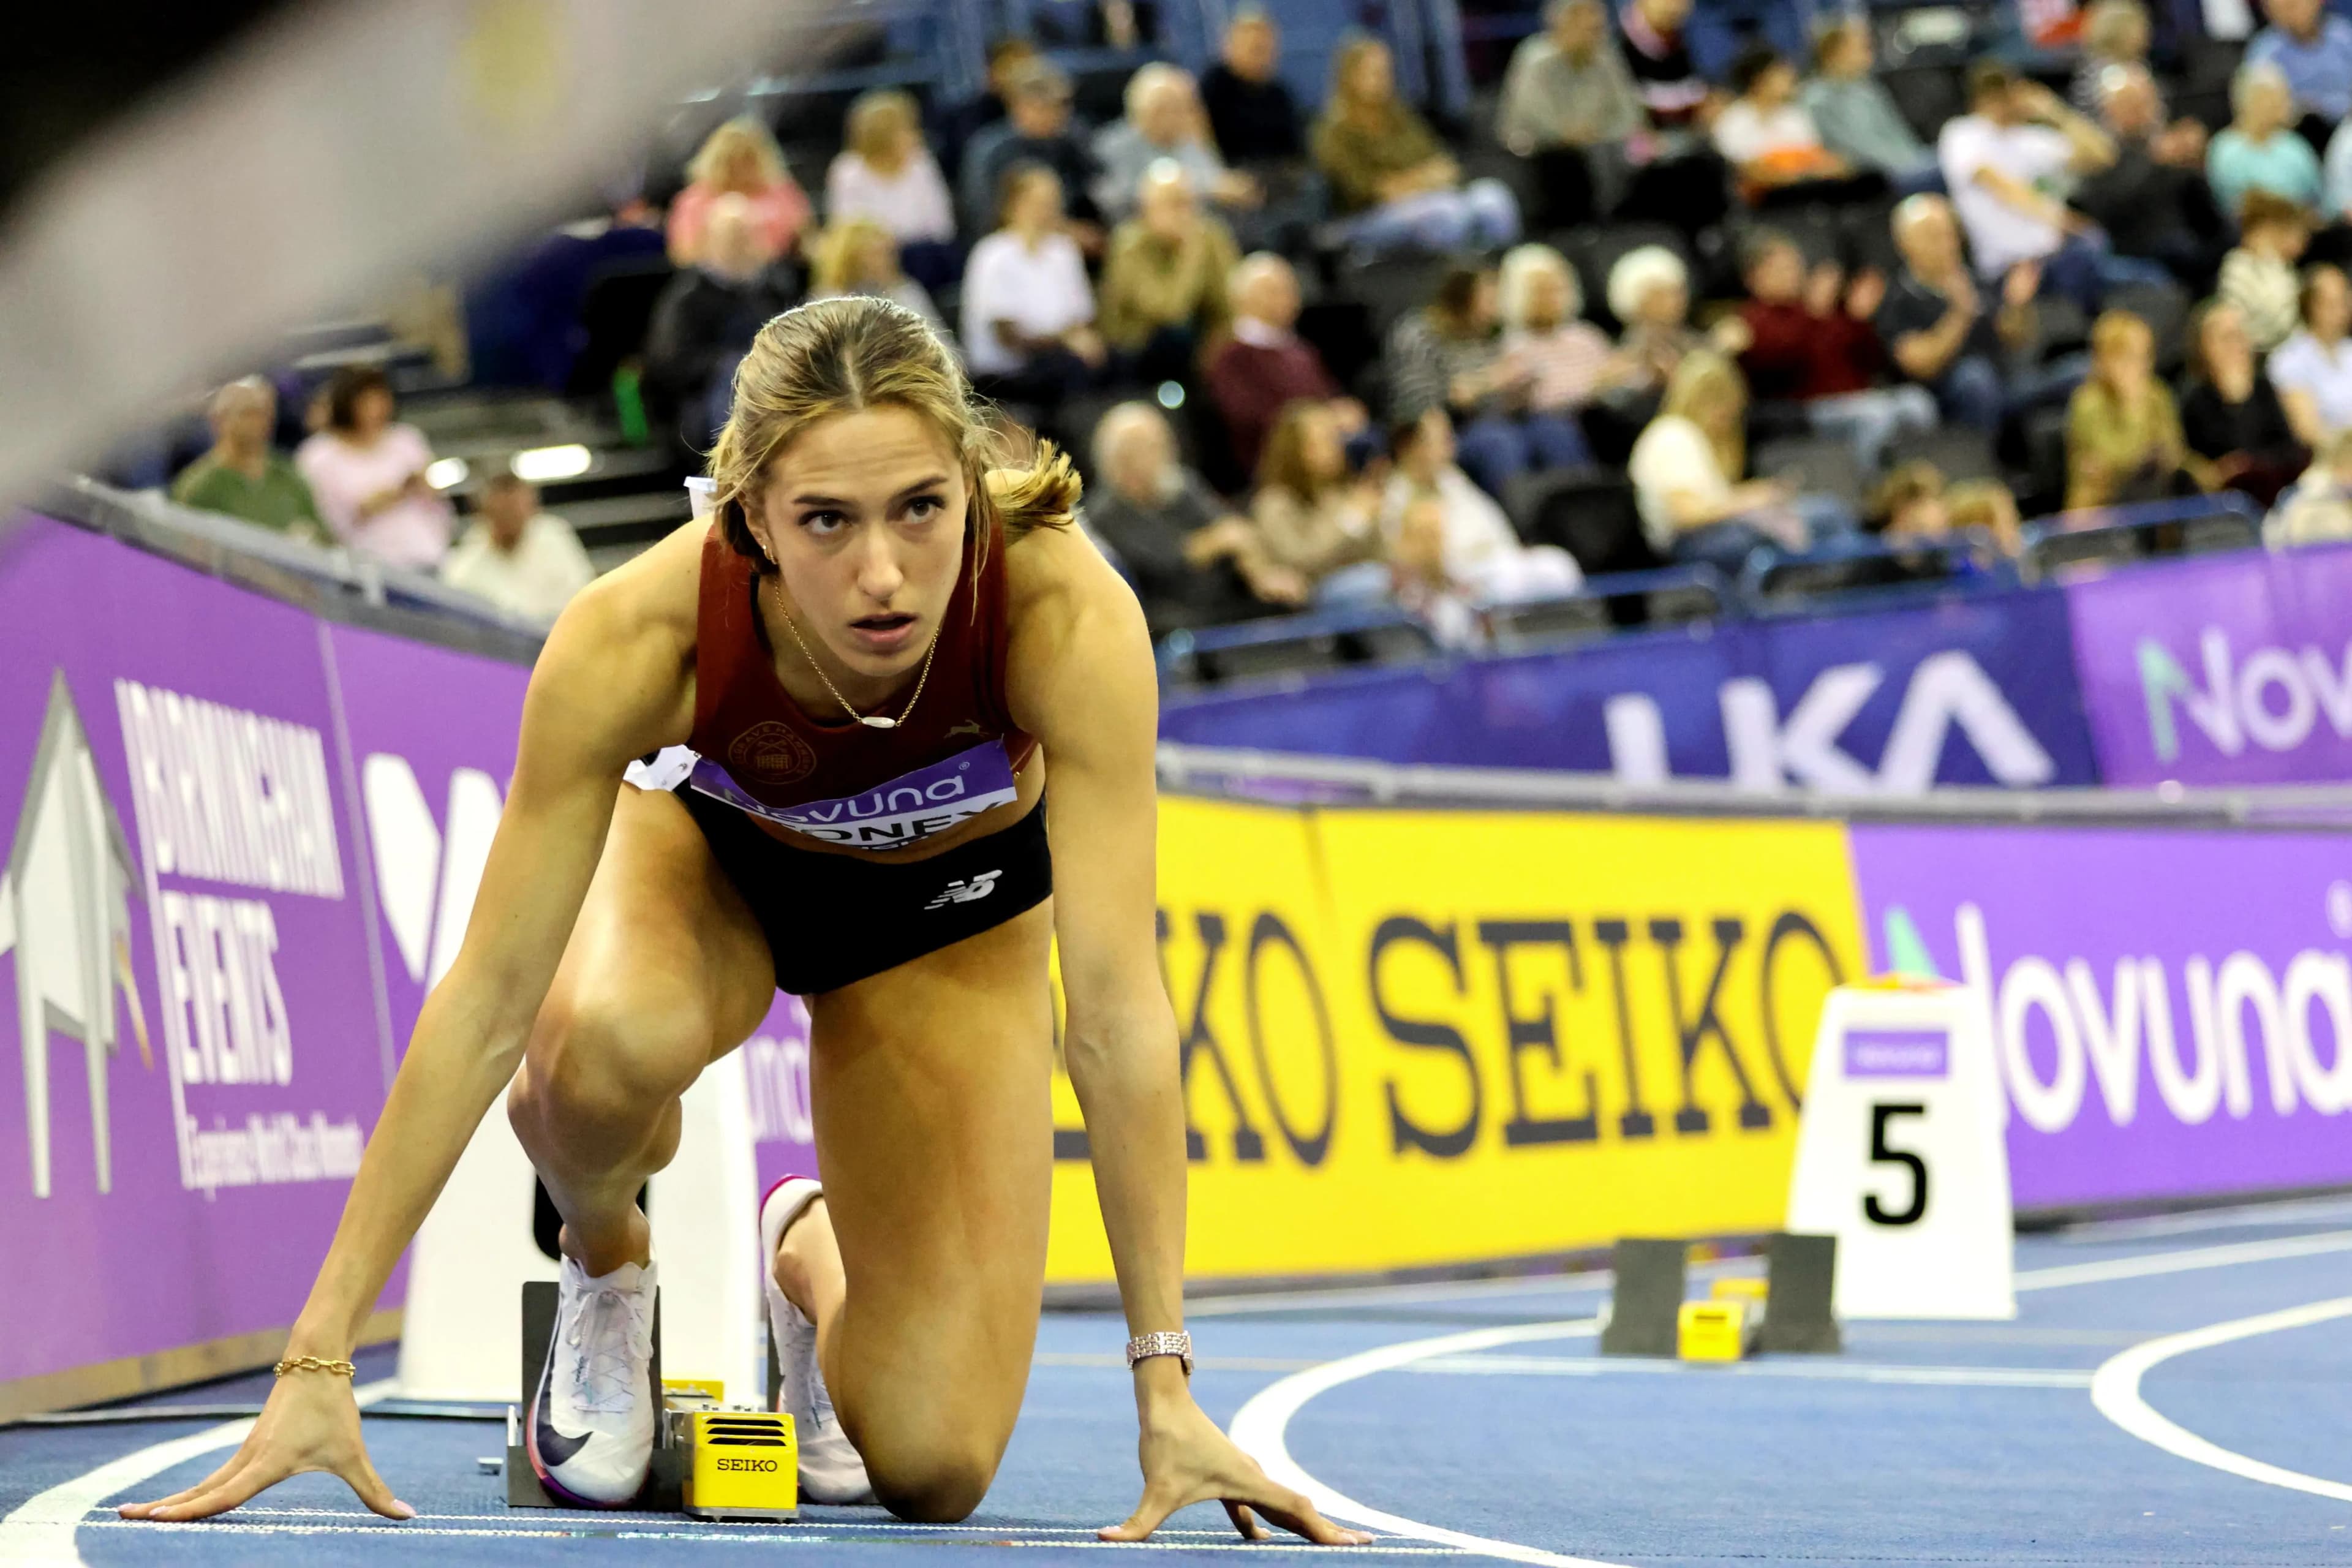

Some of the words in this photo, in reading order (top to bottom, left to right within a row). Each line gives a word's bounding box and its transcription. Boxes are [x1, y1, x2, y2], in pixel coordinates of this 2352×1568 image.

[161, 889, 293, 1087] EVENTS
[1368, 911, 1848, 1159] SEIKO
[1864, 1103, 1928, 1226] 5
[717, 1458, 778, 1472] SEIKO
